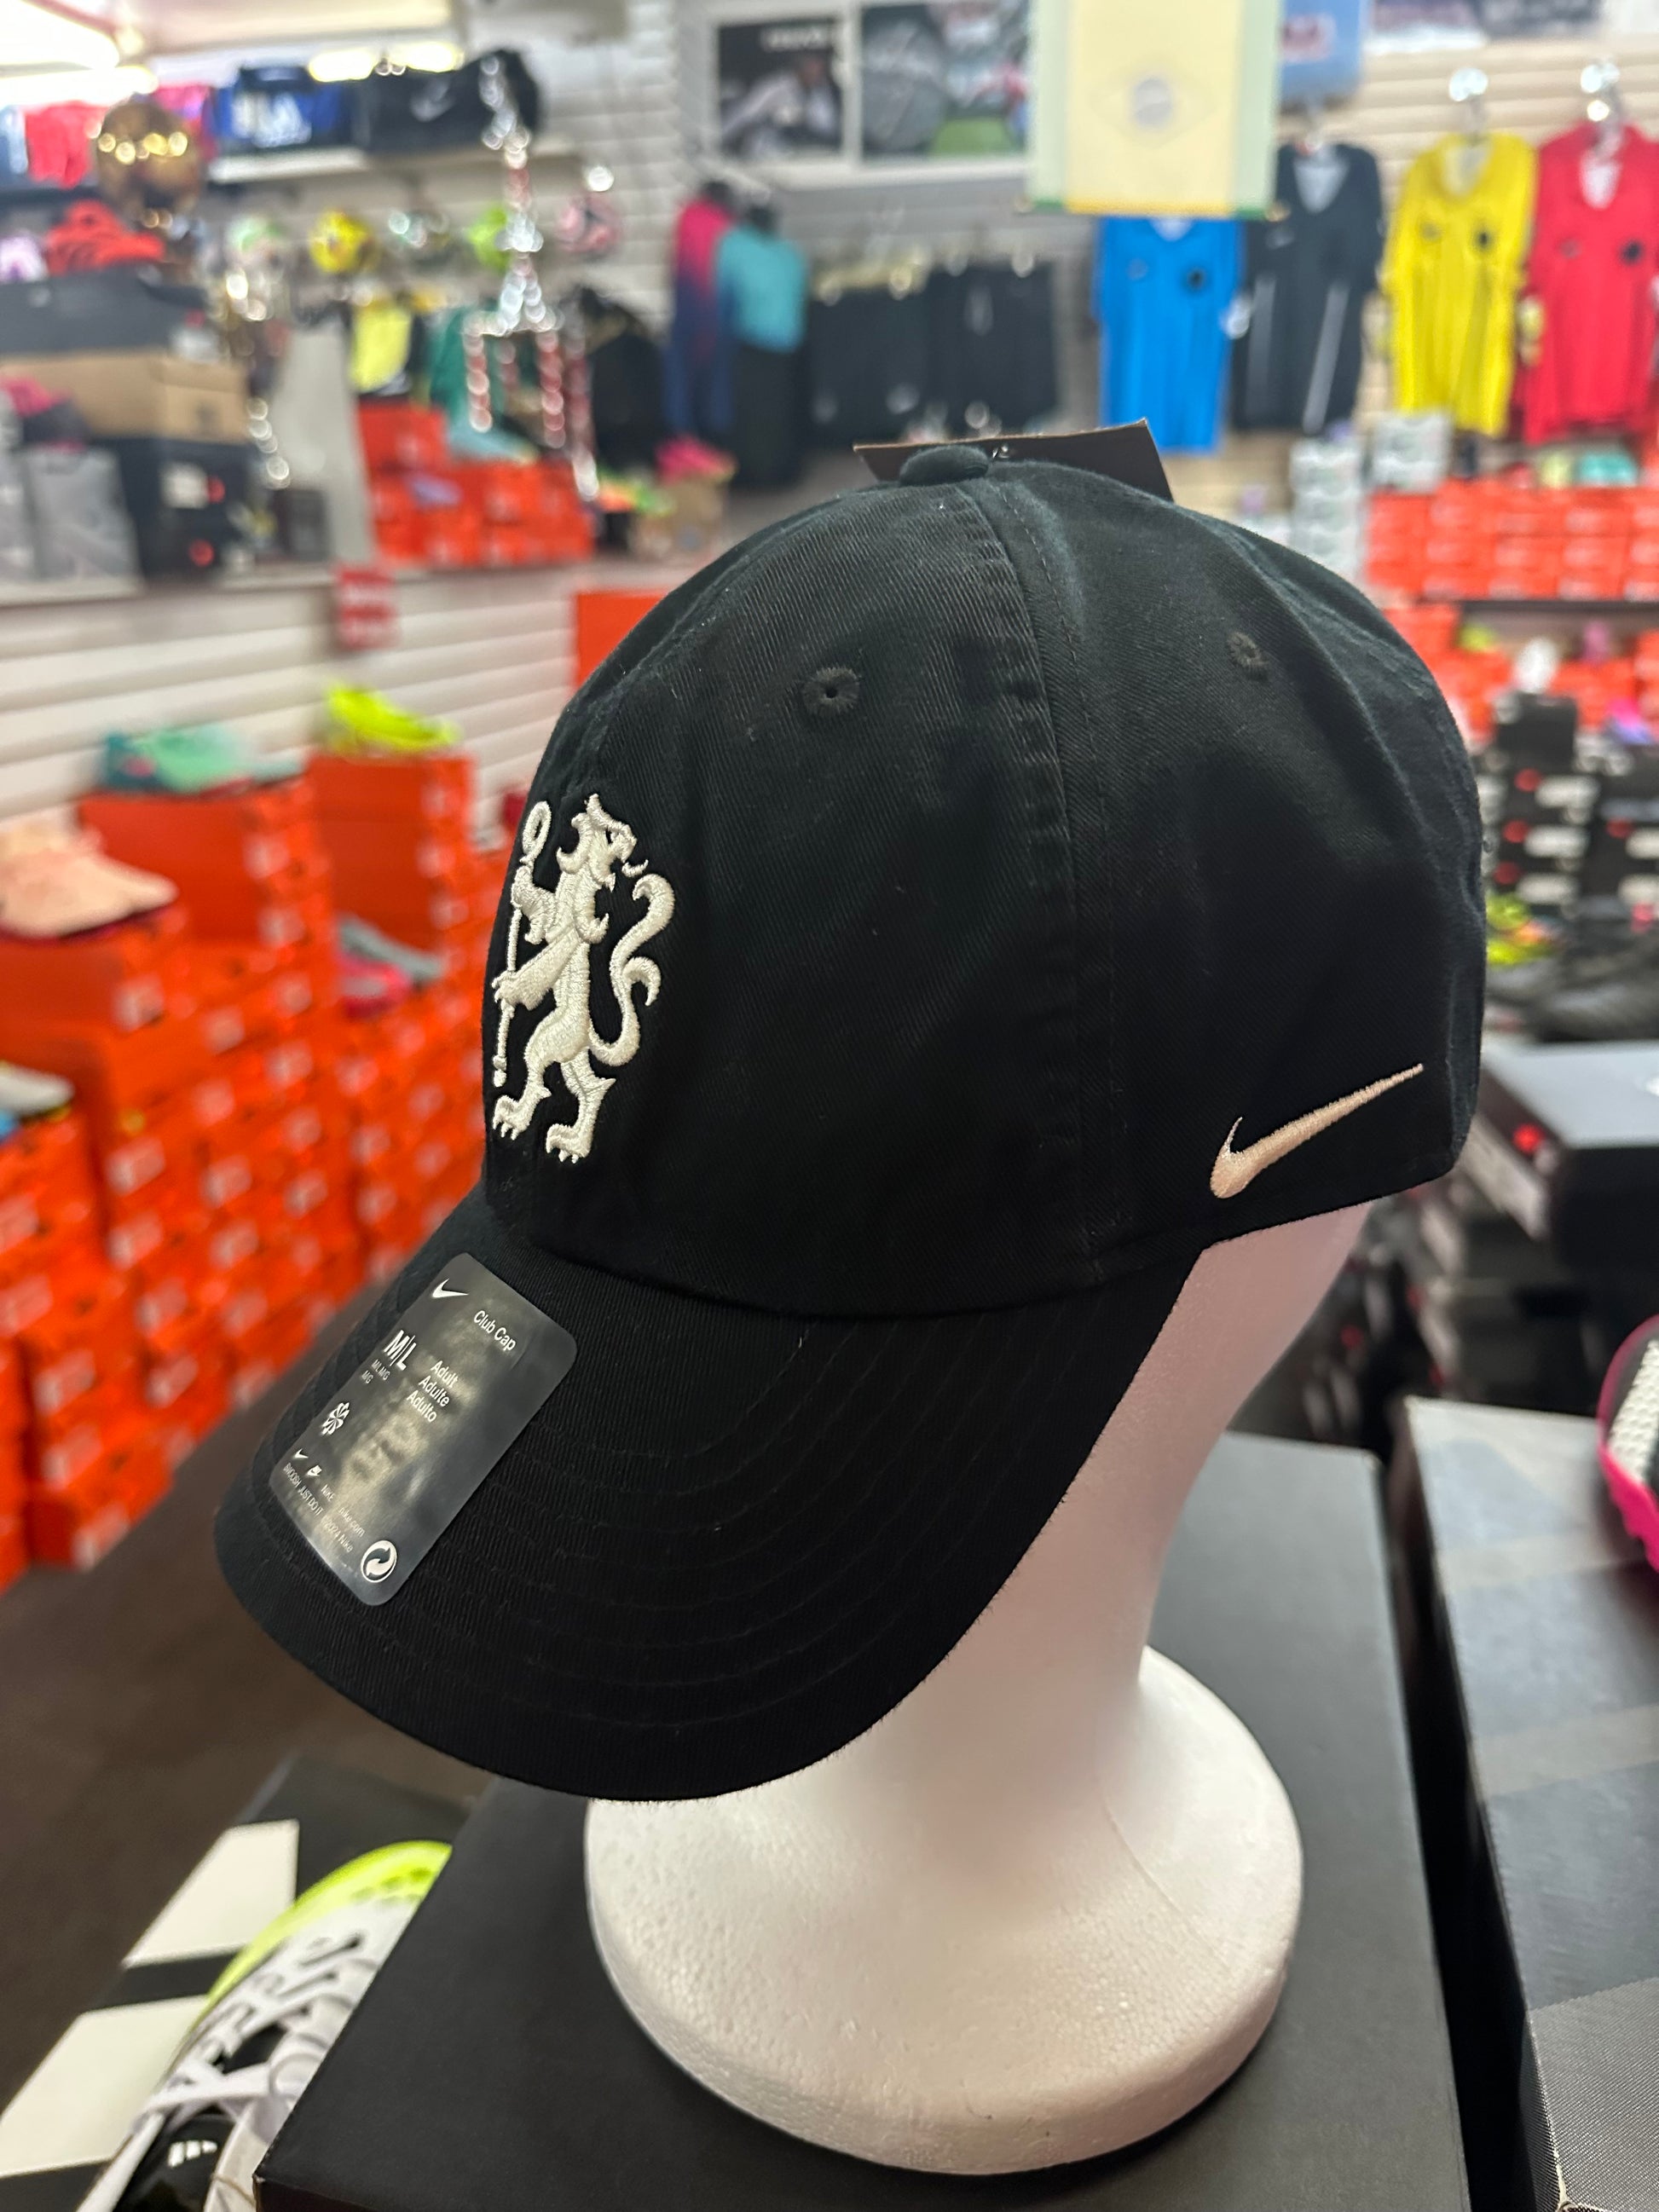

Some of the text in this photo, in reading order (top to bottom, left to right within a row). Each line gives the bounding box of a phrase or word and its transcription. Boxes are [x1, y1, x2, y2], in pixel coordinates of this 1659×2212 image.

[474, 1310, 517, 1352] Club Cap
[430, 1360, 459, 1389] Adult
[406, 1389, 437, 1423] Adulto
[418, 1375, 450, 1407] Adulte
[298, 1485, 313, 1503] JUST
[307, 1498, 320, 1512] DO
